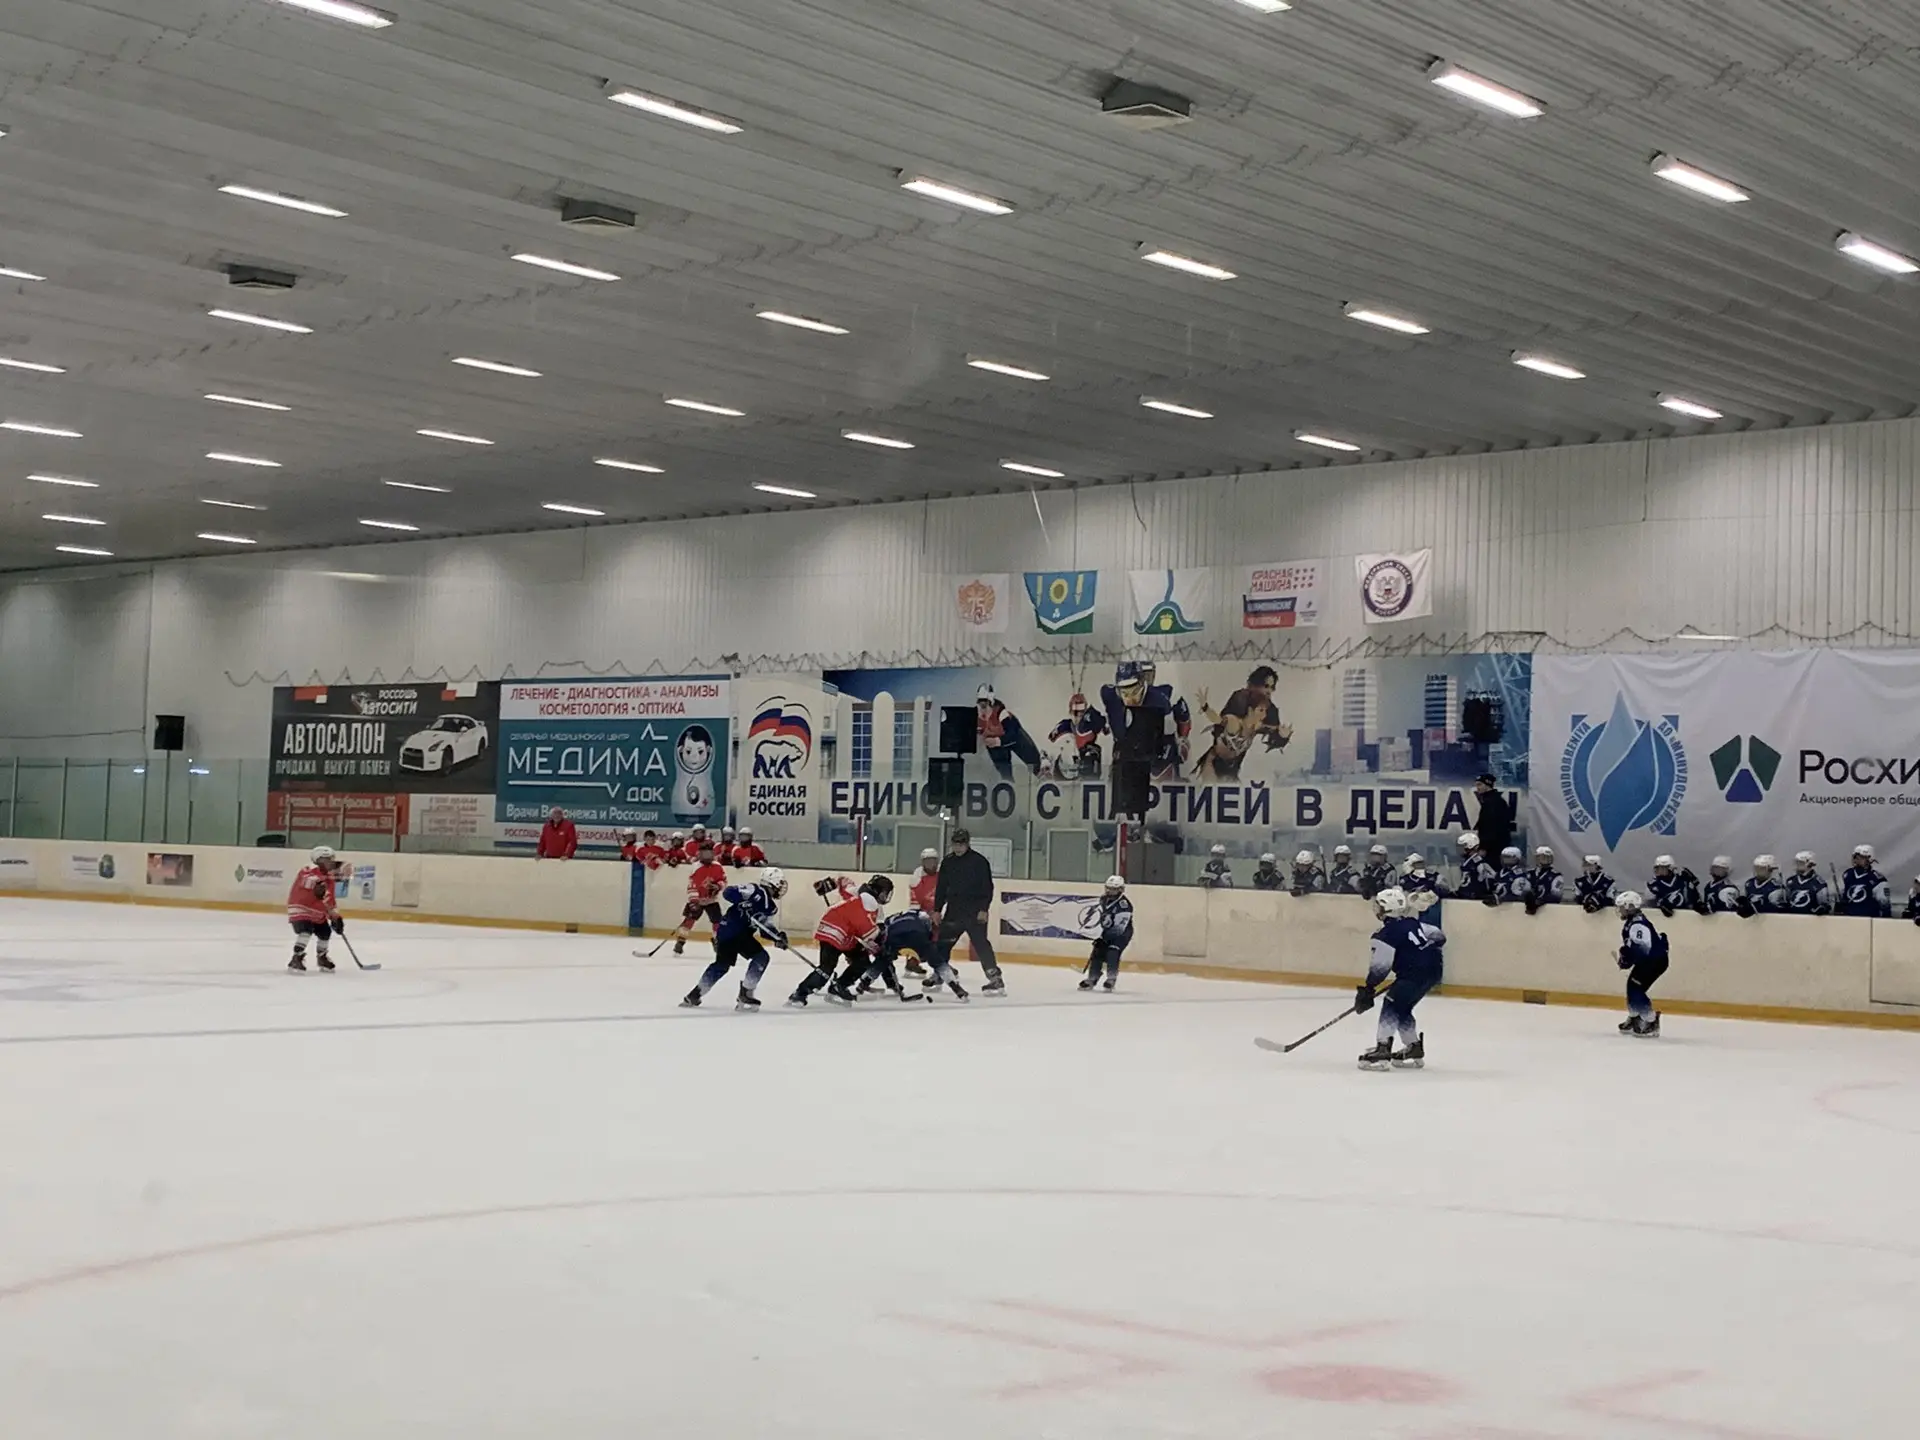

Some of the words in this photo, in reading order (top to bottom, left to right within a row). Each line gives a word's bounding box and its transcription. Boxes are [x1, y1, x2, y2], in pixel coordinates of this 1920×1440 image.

[511, 688, 560, 700] ЛЕЧЕНИЕ
[567, 686, 650, 701] ДИАГНОСТИКА
[660, 685, 719, 698] АНАЛИЗЫ
[361, 701, 418, 715] АВТОСИТИ
[539, 702, 629, 716] КОСМЕТОЛОГИЯ
[638, 702, 685, 715] ОПТИКА
[1657, 721, 1673, 738] АО
[283, 722, 386, 755] АВТОСАЛОН
[275, 759, 316, 775] ПРОДАЖА
[324, 760, 355, 775] ВЫКУП
[360, 760, 392, 775] ОБМЕН
[508, 746, 668, 777] МЕДИМА
[626, 786, 664, 802] ДОК
[749, 785, 807, 799] ЕДИНАЯ
[831, 781, 1016, 821] ЕДИНСВО
[1037, 782, 1060, 821] С
[1297, 788, 1322, 826] В
[1346, 788, 1519, 835] ДЕЛА!
[1799, 793, 1886, 808] Акционерное
[506, 804, 538, 820] Врачи
[541, 805, 598, 820] Воонежа
[609, 806, 659, 821] Россоши
[748, 802, 806, 817] РОССИЯ
